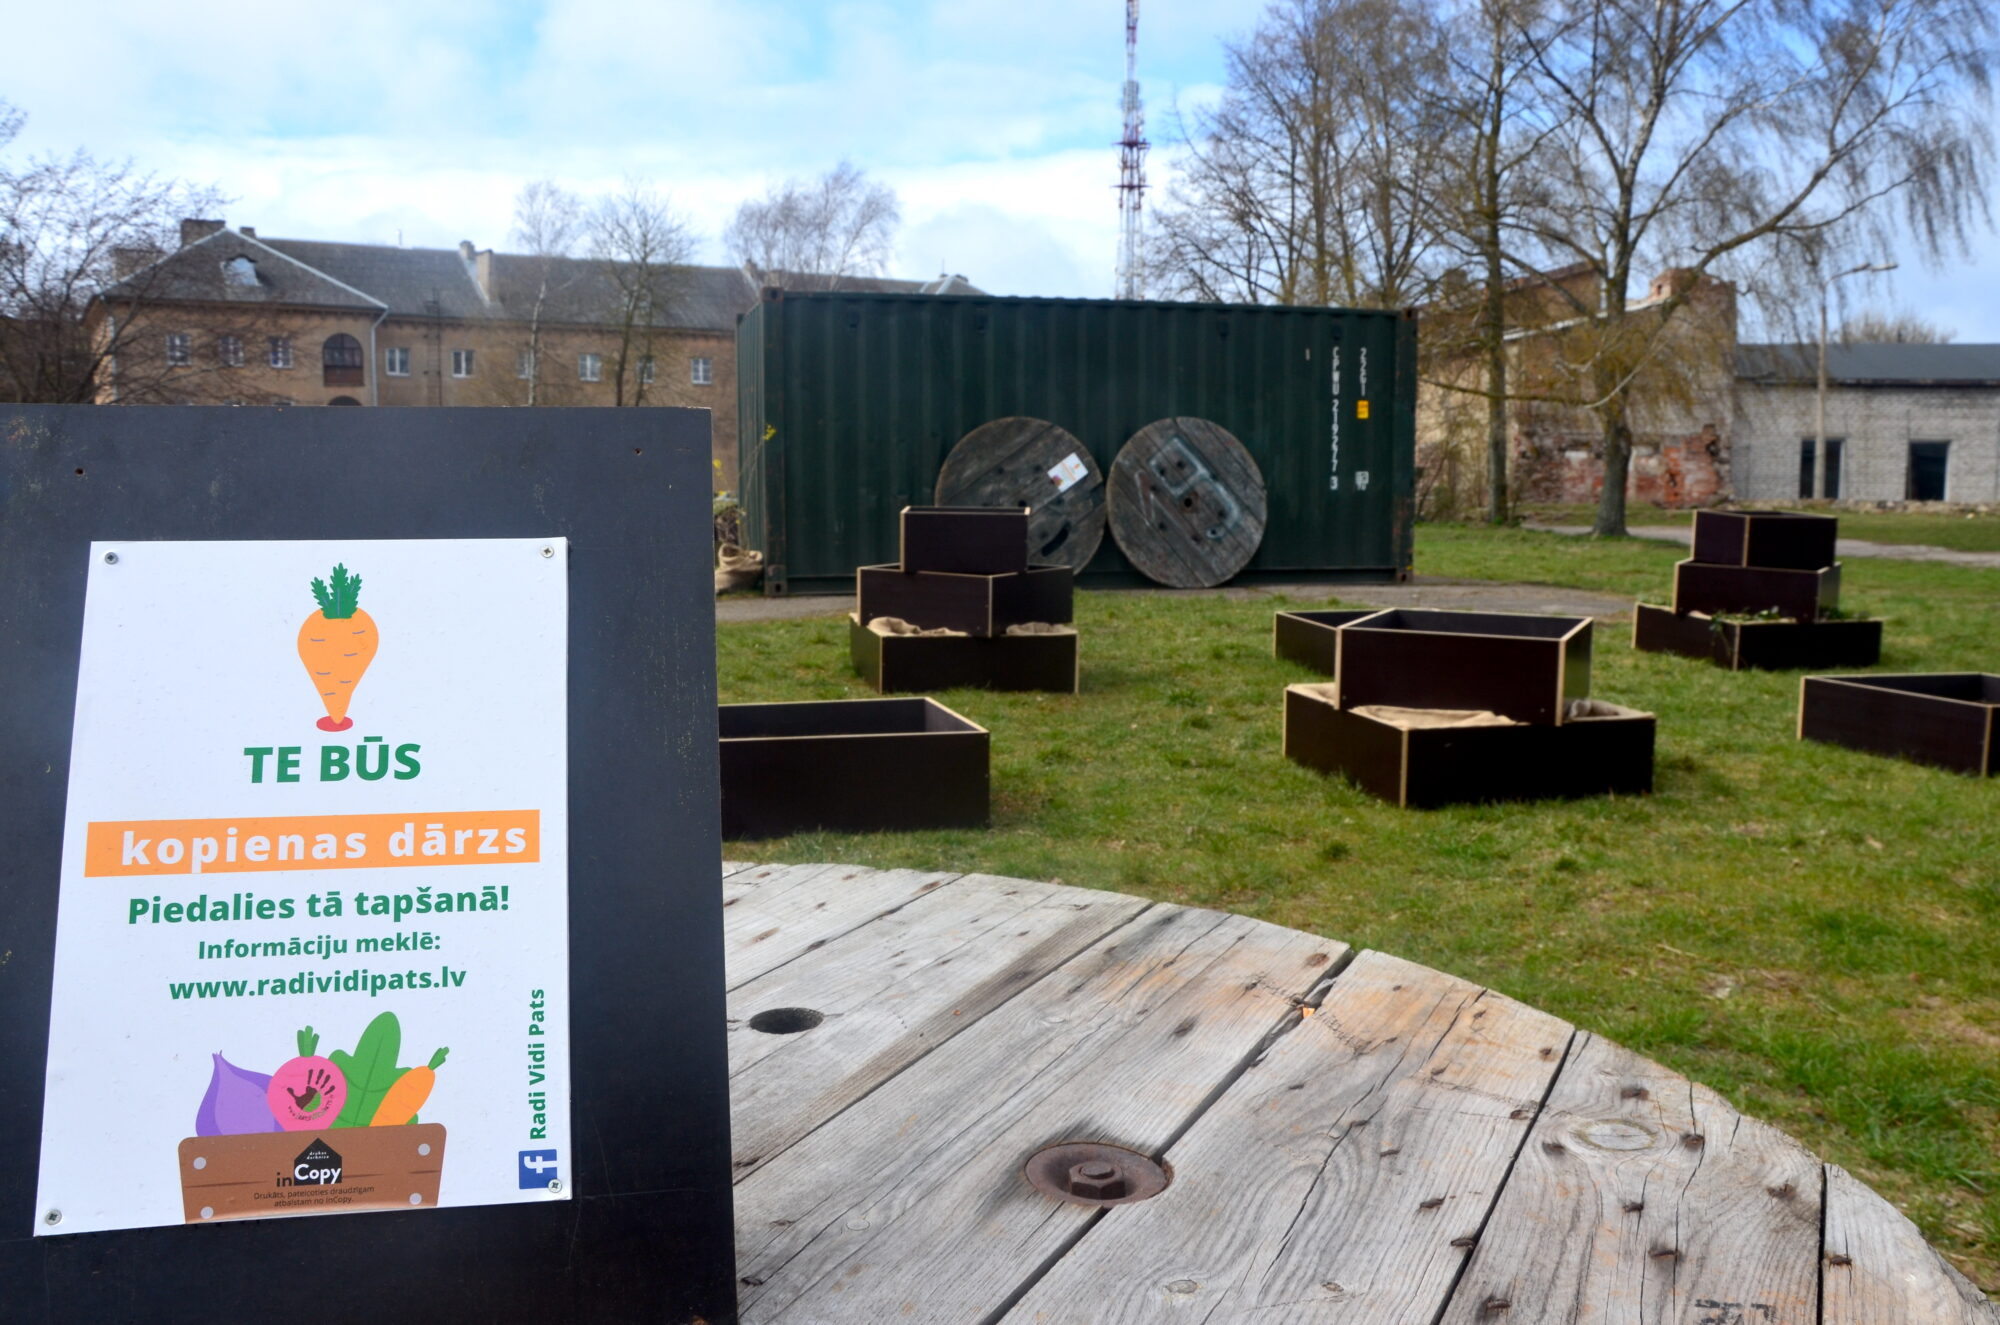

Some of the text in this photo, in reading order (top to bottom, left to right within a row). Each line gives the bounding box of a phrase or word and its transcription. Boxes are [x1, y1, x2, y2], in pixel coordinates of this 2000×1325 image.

[243, 735, 422, 785] TE BŪS
[121, 822, 527, 874] kopienas dārzs
[128, 885, 510, 925] Piedalies tā tapšanā!
[198, 931, 441, 961] Informāciju meklē:
[169, 966, 467, 1001] www.radividipats.lv
[528, 989, 547, 1140] Radi Vidi Pats
[276, 1163, 342, 1188] inCopy
[274, 1198, 312, 1208] atbalstam
[314, 1198, 324, 1206] no
[287, 1188, 329, 1199] pateicoties
